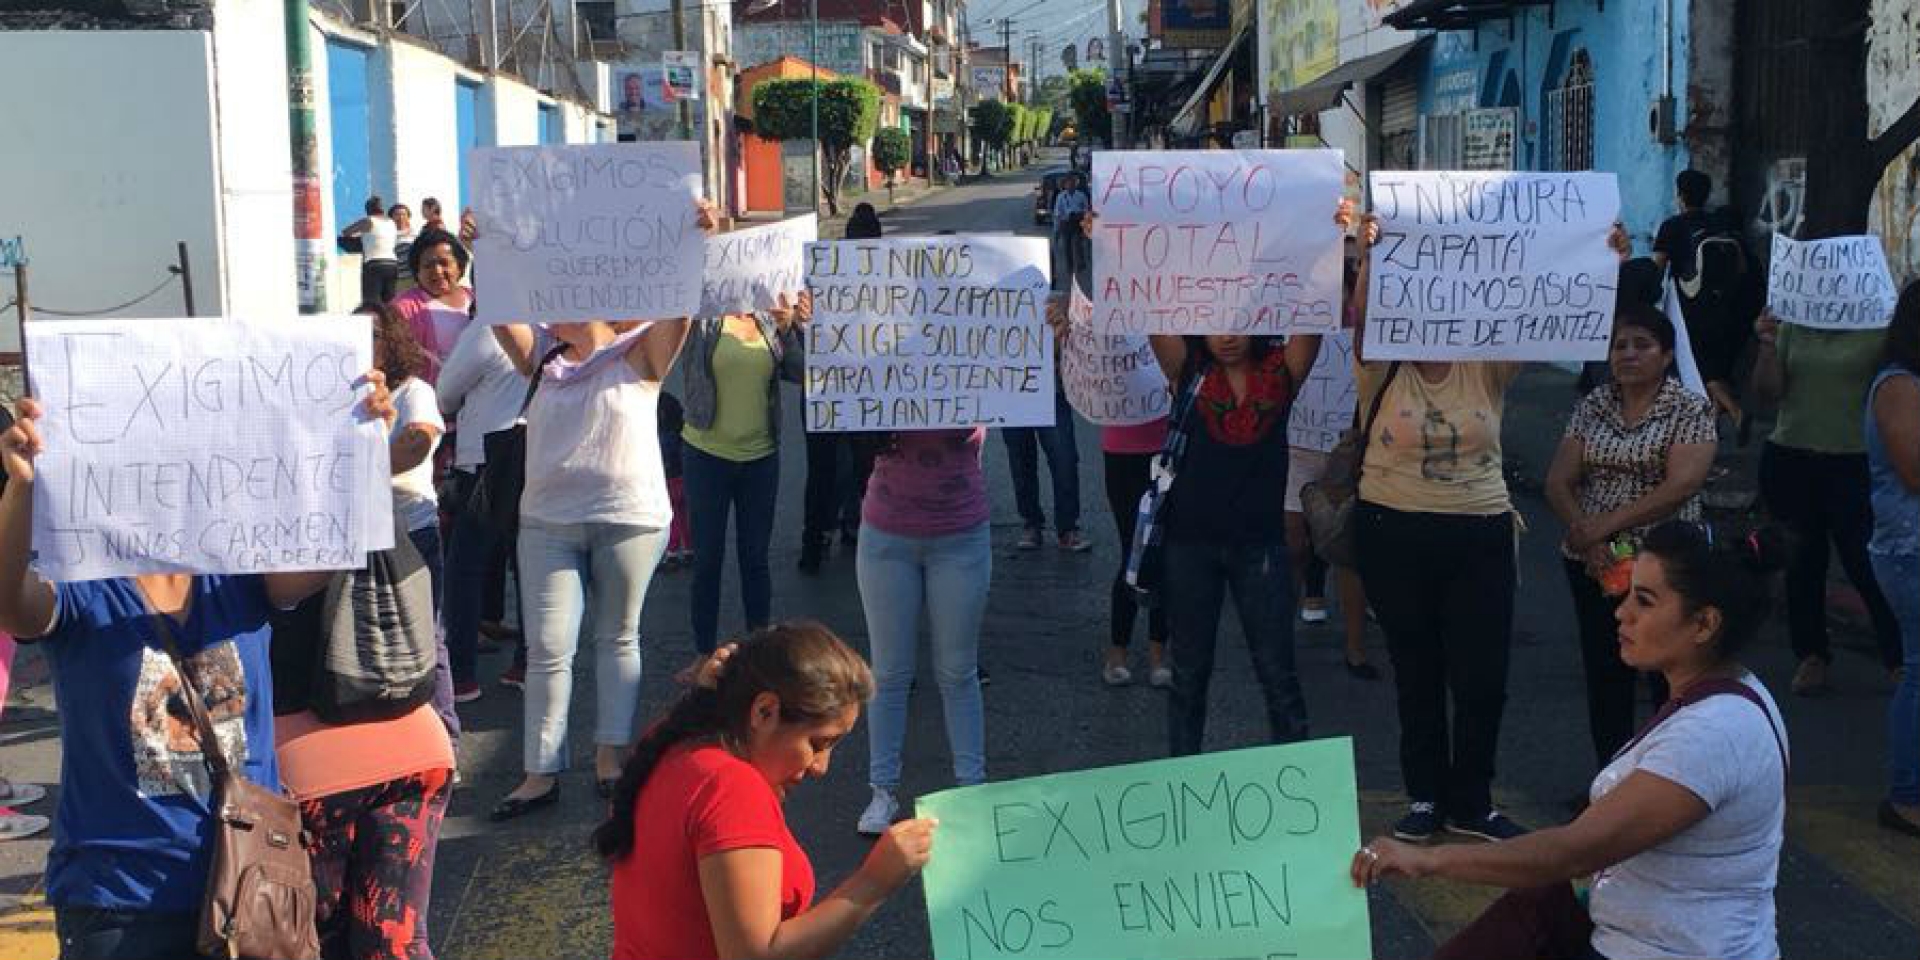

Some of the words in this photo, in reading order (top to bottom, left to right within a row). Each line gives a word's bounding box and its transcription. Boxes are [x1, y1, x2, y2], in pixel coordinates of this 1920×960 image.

[489, 154, 683, 196] EXIGIMOS
[1102, 164, 1277, 214] APOYO
[1378, 182, 1405, 221] J
[486, 205, 688, 252] SOLUCIÓN
[1103, 221, 1290, 270] TOTAL
[546, 254, 679, 278] QUEREMOS
[810, 246, 846, 276] EL
[889, 244, 974, 279] NIÑOS
[1773, 237, 1878, 270] EXIGIMOS
[528, 283, 685, 312] INTENDENTE
[1104, 277, 1121, 301] A
[1131, 273, 1302, 303] NUESTRAS
[1379, 273, 1526, 314] EXIGIMOS
[1772, 264, 1889, 297] SOLUCION
[809, 322, 912, 357] EXIGE
[922, 322, 1044, 359] SOLUCION
[1371, 317, 1467, 346] TENTE
[1469, 319, 1507, 346] DE
[58, 332, 357, 444] EXIGIMOS
[808, 364, 875, 395] PARA
[884, 362, 1042, 393] ASISTENTE
[810, 400, 848, 430] DE
[68, 453, 355, 523] INTENDENTE
[50, 527, 95, 566] J
[198, 509, 351, 566] CARMEN
[993, 765, 1320, 863] EXIGIMOS
[961, 889, 1074, 960] NOS
[1113, 863, 1292, 932] ENVIEN
